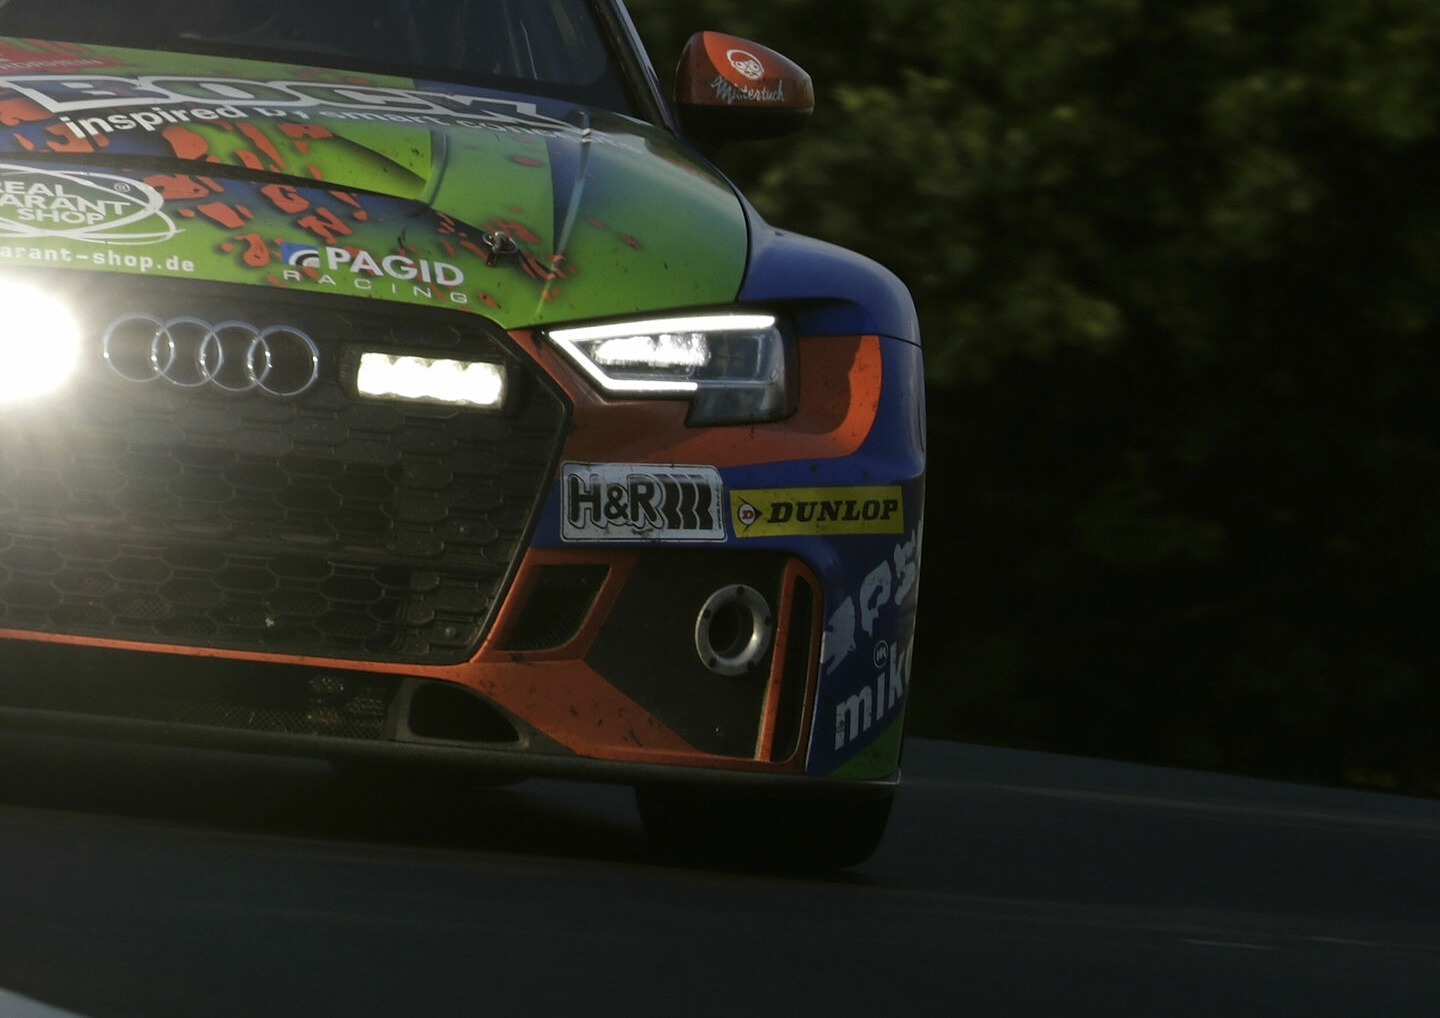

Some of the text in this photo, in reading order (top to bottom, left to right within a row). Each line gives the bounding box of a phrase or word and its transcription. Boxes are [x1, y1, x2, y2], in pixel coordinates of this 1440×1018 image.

[60, 104, 248, 138] inspired
[253, 107, 310, 120] by
[323, 112, 444, 126] smart
[16, 206, 106, 225] SHOP
[326, 246, 465, 287] PAGID
[283, 268, 469, 304] RACING
[568, 473, 666, 530] H&R
[767, 497, 899, 524] DUNLOP
